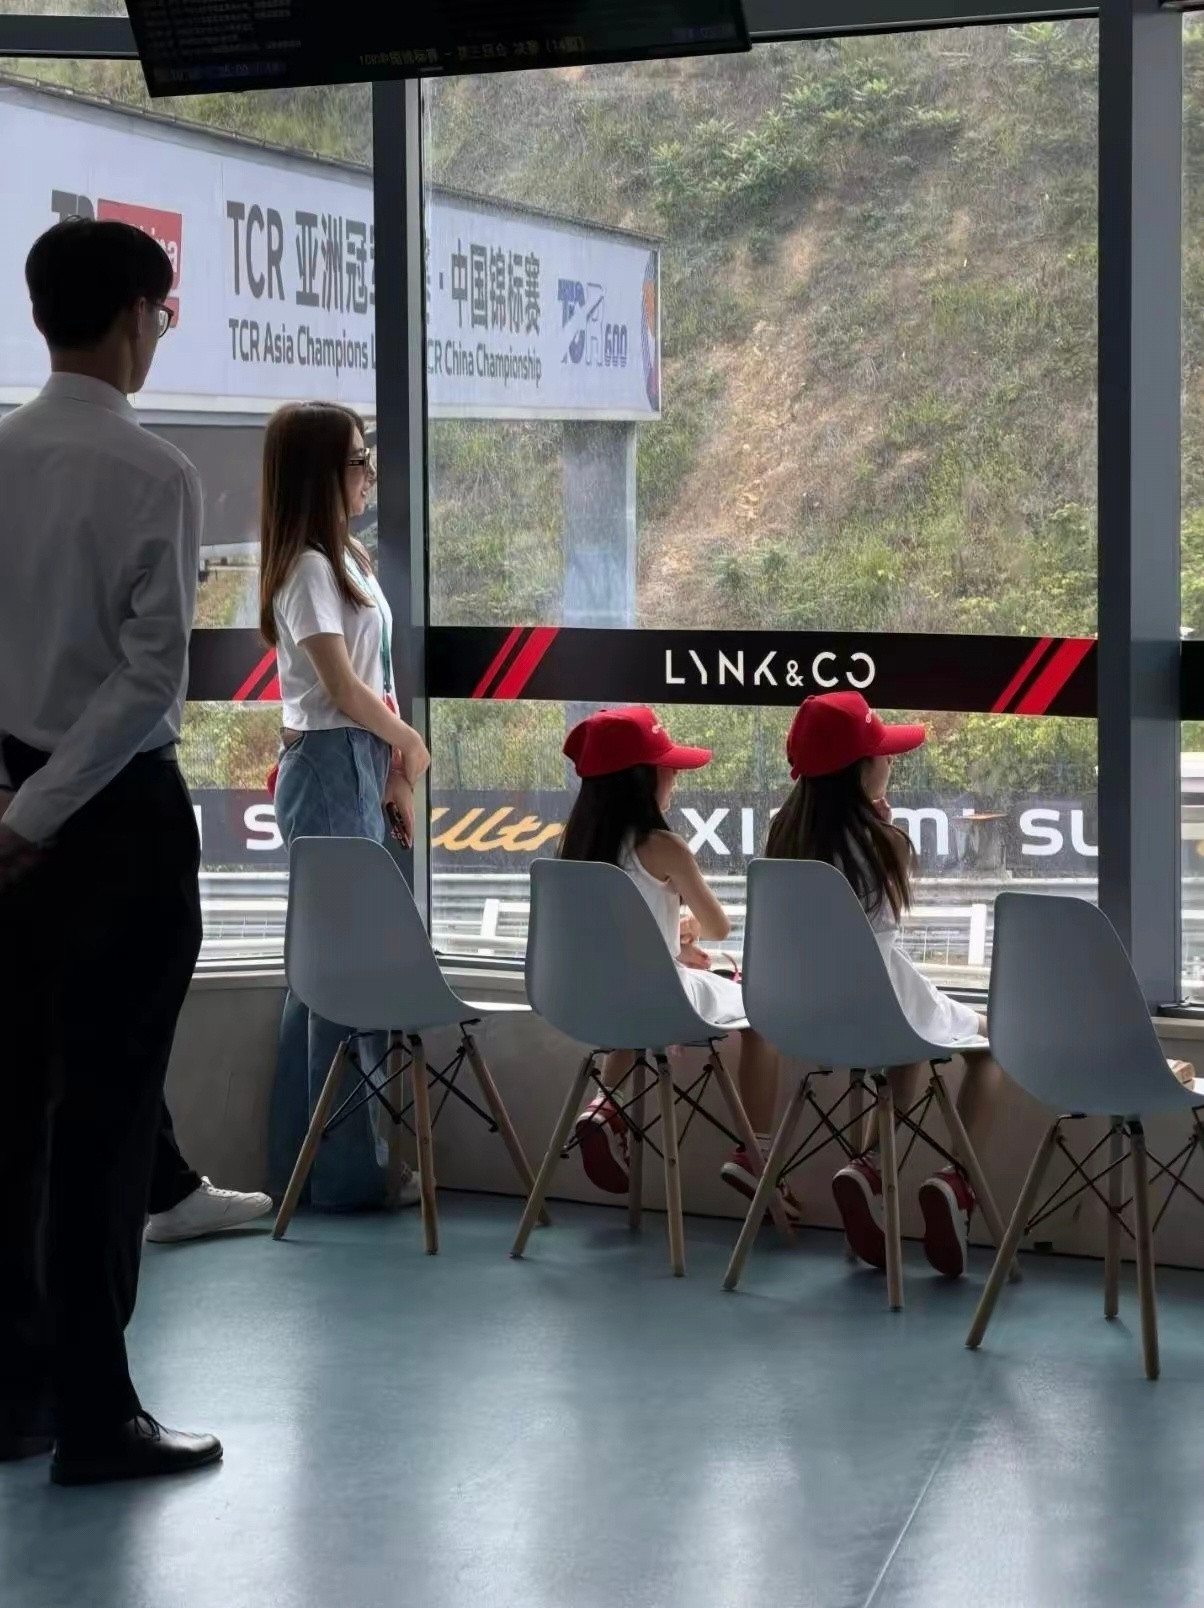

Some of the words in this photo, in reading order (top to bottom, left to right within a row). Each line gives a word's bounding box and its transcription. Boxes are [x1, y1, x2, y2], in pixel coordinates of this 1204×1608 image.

[226, 200, 285, 301] TCR
[228, 317, 260, 362] TCR
[263, 321, 294, 364] Asia
[297, 325, 368, 378] Champions
[426, 338, 442, 374] CR
[445, 339, 475, 377] China
[476, 342, 542, 389] Championship
